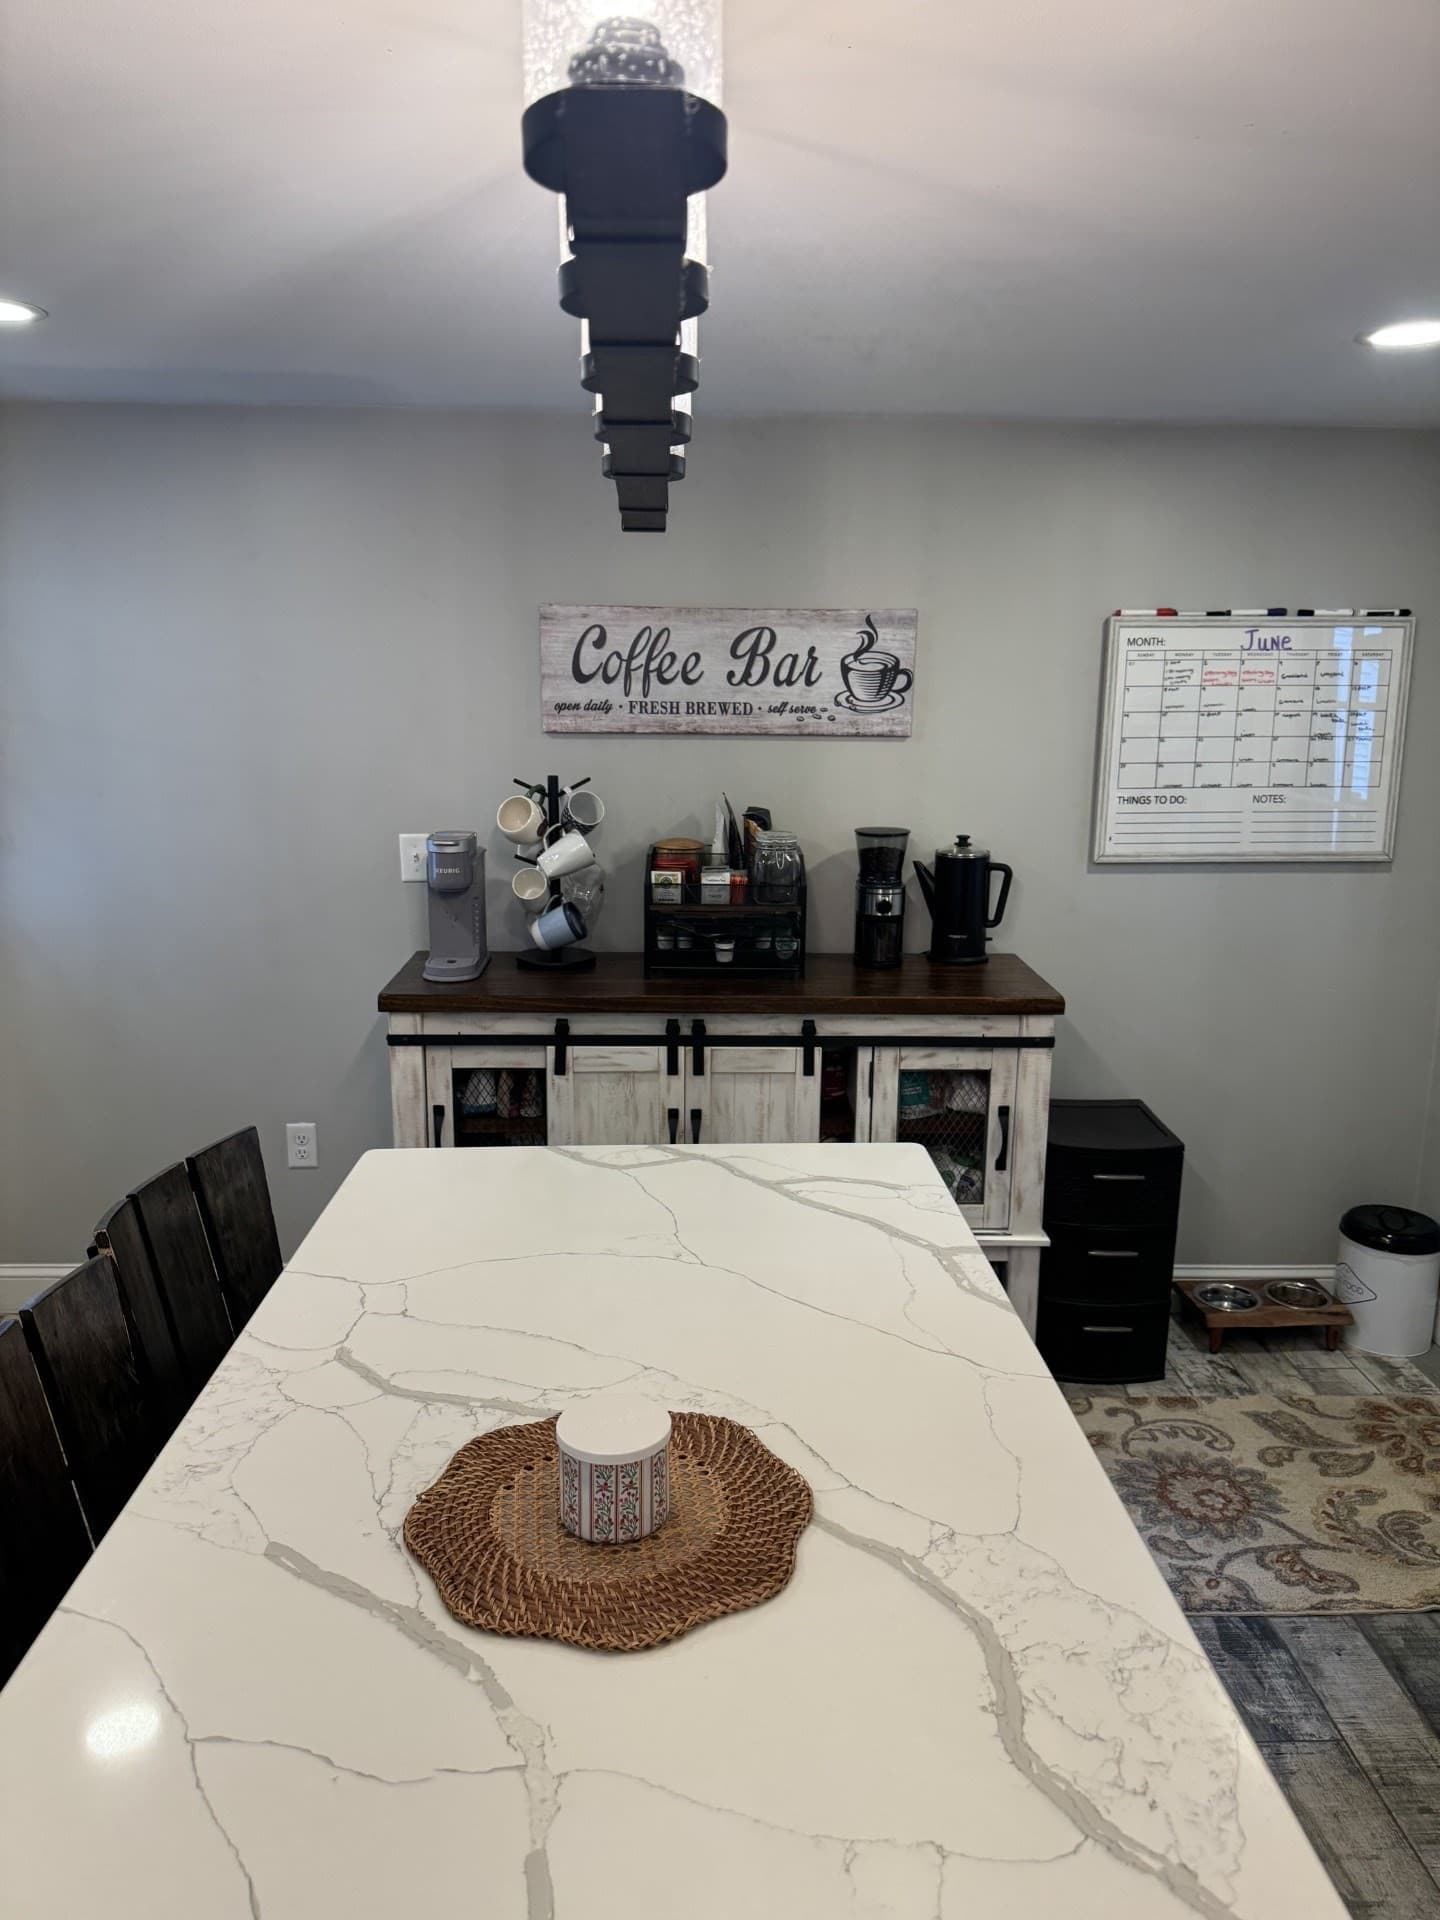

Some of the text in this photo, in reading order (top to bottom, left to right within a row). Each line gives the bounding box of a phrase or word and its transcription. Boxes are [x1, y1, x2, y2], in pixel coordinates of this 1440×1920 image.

[1127, 637, 1166, 647] MONTH:
[571, 623, 823, 698] Coffee Bar
[554, 698, 613, 714] open daily
[628, 700, 754, 716] FRESH BREWED
[767, 700, 817, 717] self serve
[1117, 795, 1187, 805] THINGS TO DO:
[1252, 794, 1287, 804] NOTES:
